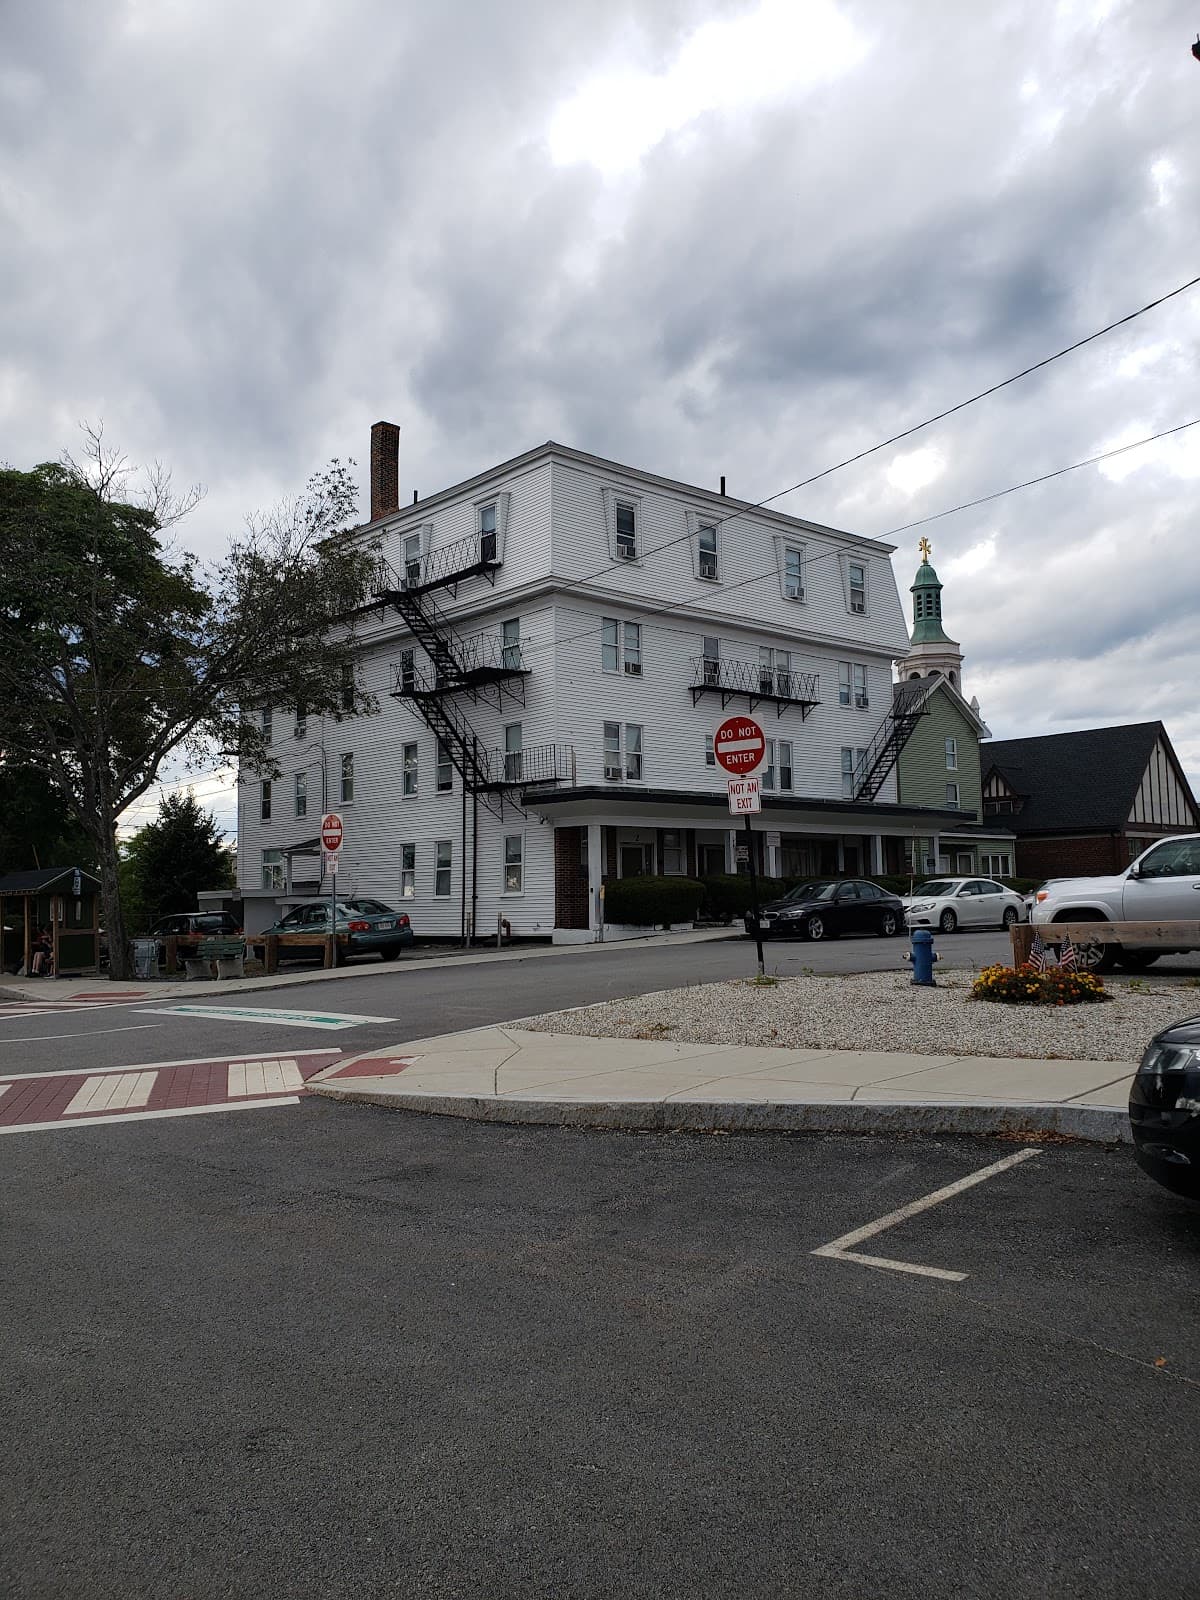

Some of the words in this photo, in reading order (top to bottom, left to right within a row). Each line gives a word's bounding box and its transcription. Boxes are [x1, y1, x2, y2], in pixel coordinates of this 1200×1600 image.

[720, 729, 733, 739] DO
[738, 726, 756, 737] NOT
[726, 752, 755, 764] ENTER
[730, 783, 744, 794] NOT
[746, 782, 757, 793] AN
[736, 798, 752, 809] EXIT
